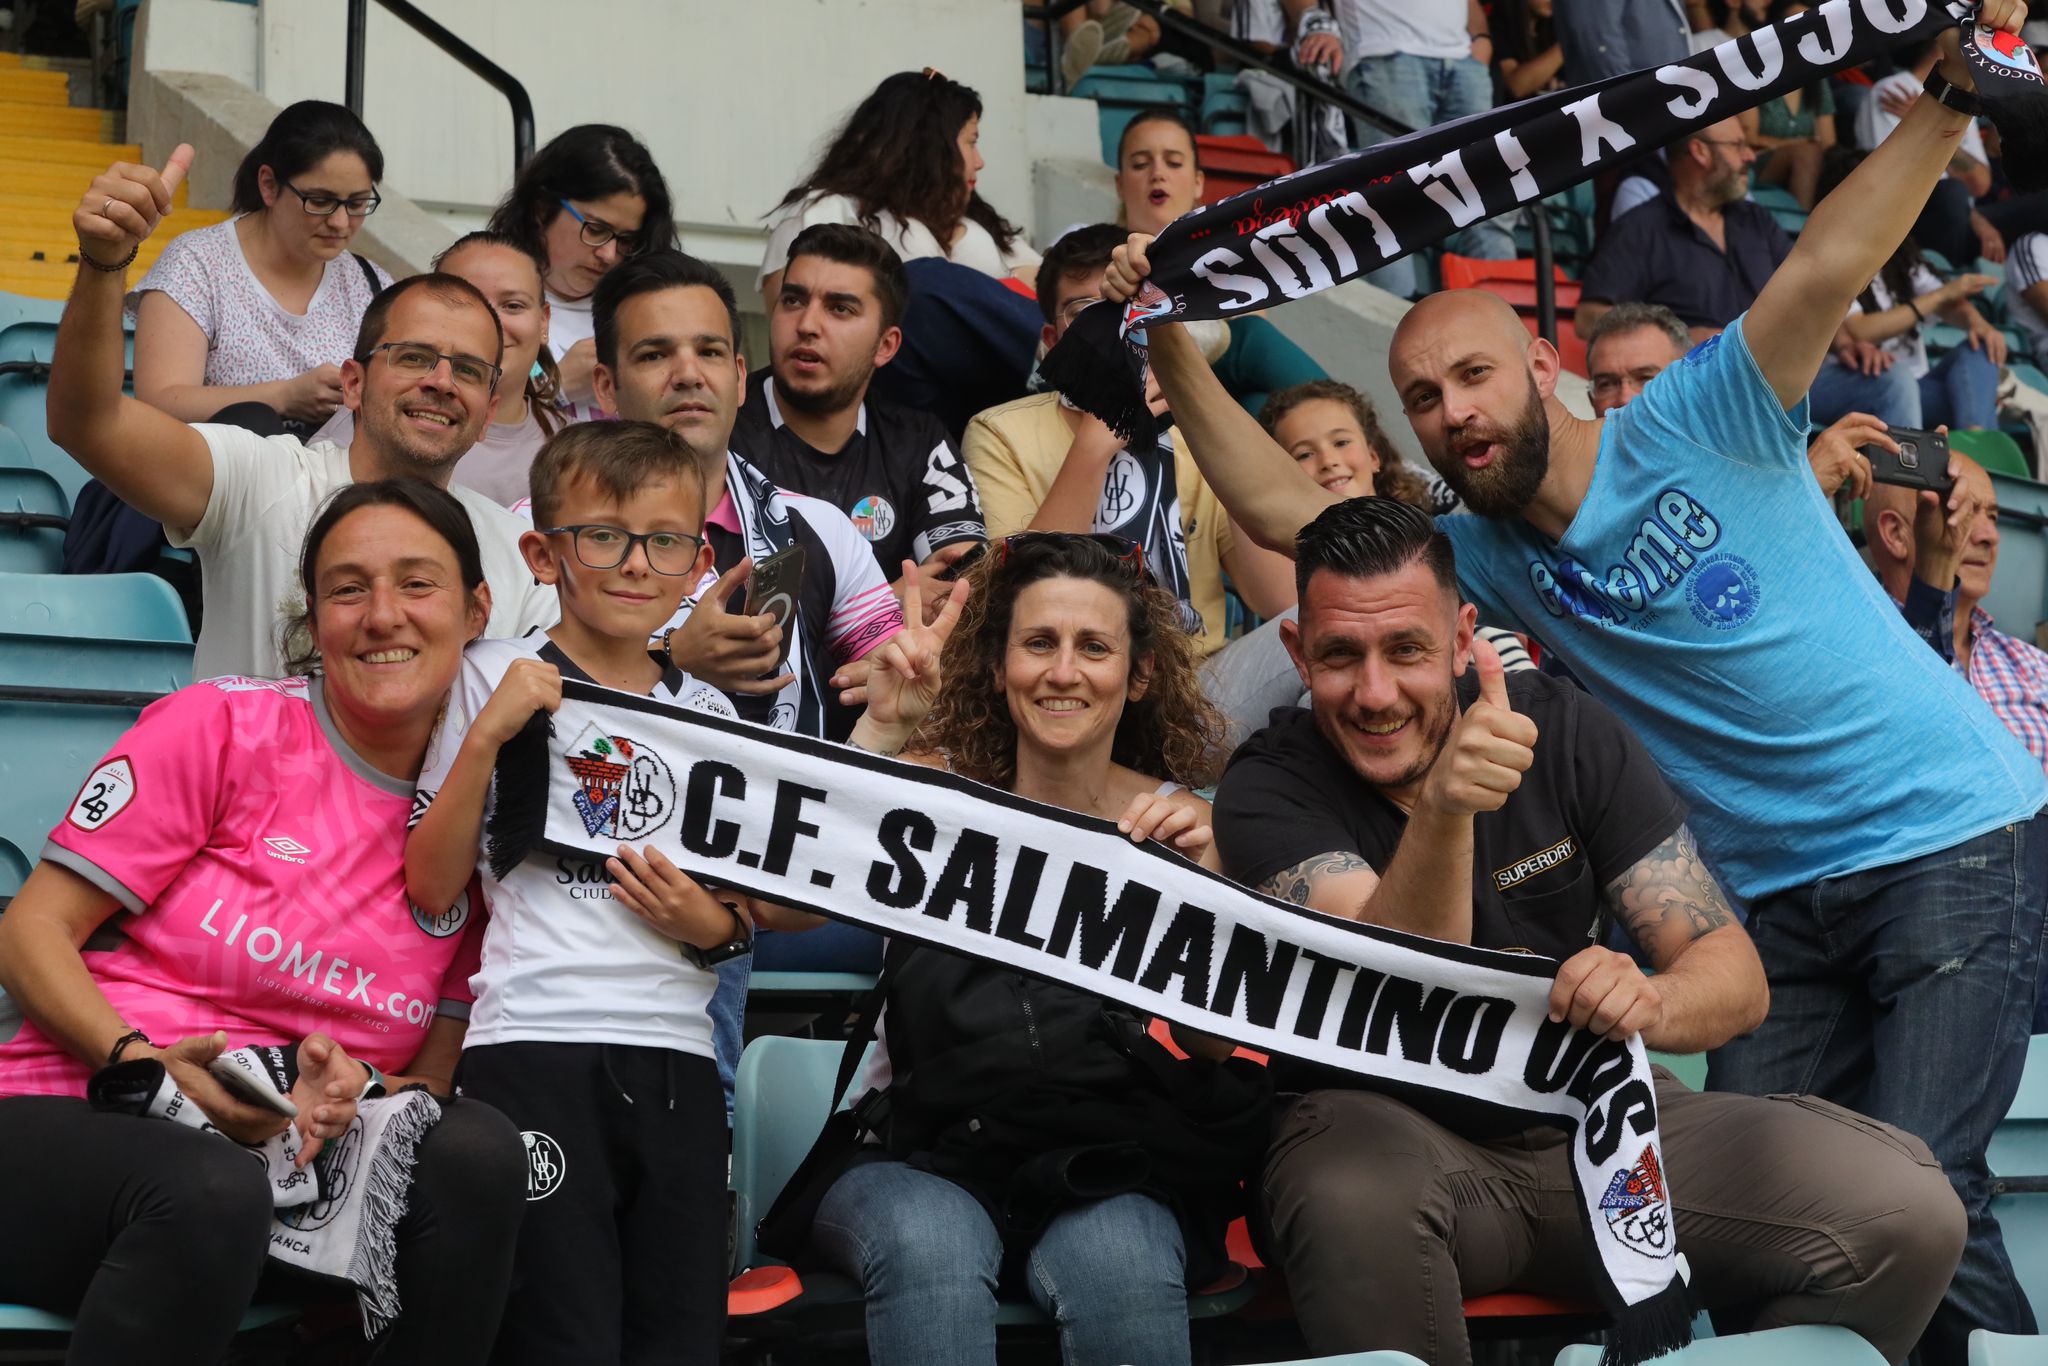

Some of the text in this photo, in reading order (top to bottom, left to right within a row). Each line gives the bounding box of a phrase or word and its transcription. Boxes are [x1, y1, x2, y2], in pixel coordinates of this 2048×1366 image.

[1655, 0, 1940, 119] OCOS
[1560, 92, 1636, 167] X
[1190, 192, 1401, 310] UDS
[266, 849, 306, 865] umbro
[570, 886, 616, 900] CIUD
[1498, 840, 1572, 886] SUPERDRY
[866, 808, 1516, 1076] SALMANTINO
